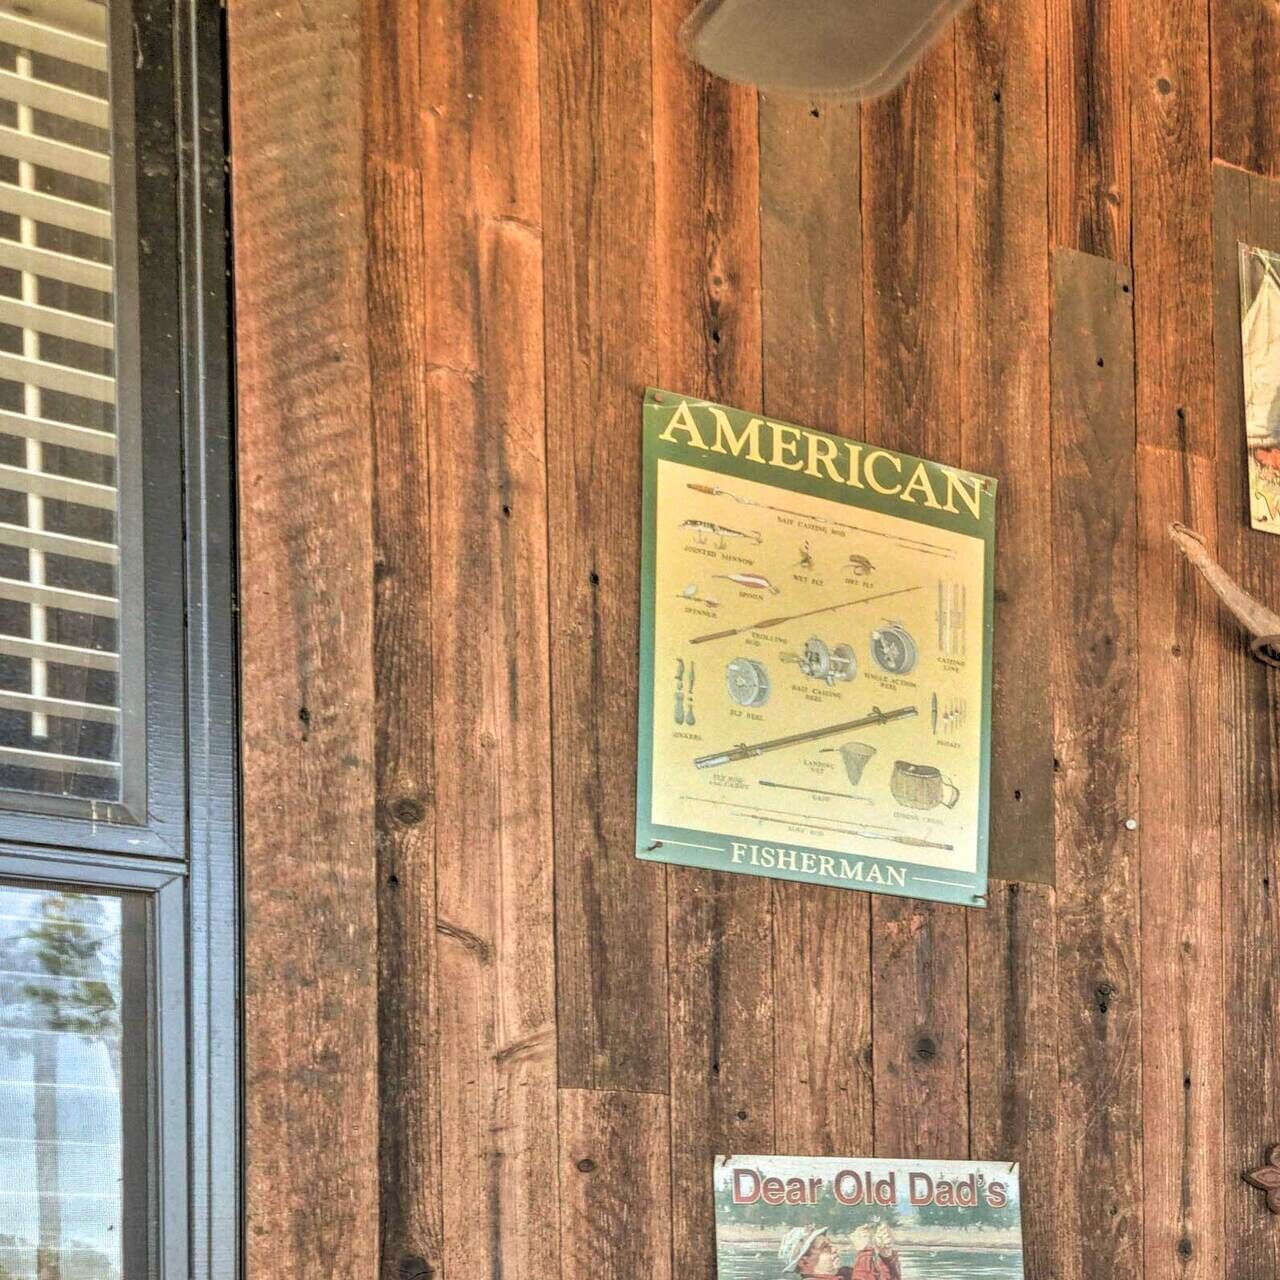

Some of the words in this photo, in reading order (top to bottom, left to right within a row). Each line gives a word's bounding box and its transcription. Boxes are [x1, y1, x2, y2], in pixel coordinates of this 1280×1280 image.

[659, 400, 986, 520] AMERICAN
[730, 842, 908, 888] FISHERMAN
[732, 1168, 822, 1206] Dear
[834, 1169, 896, 1206] Old
[908, 1171, 1007, 1207] Dad's
